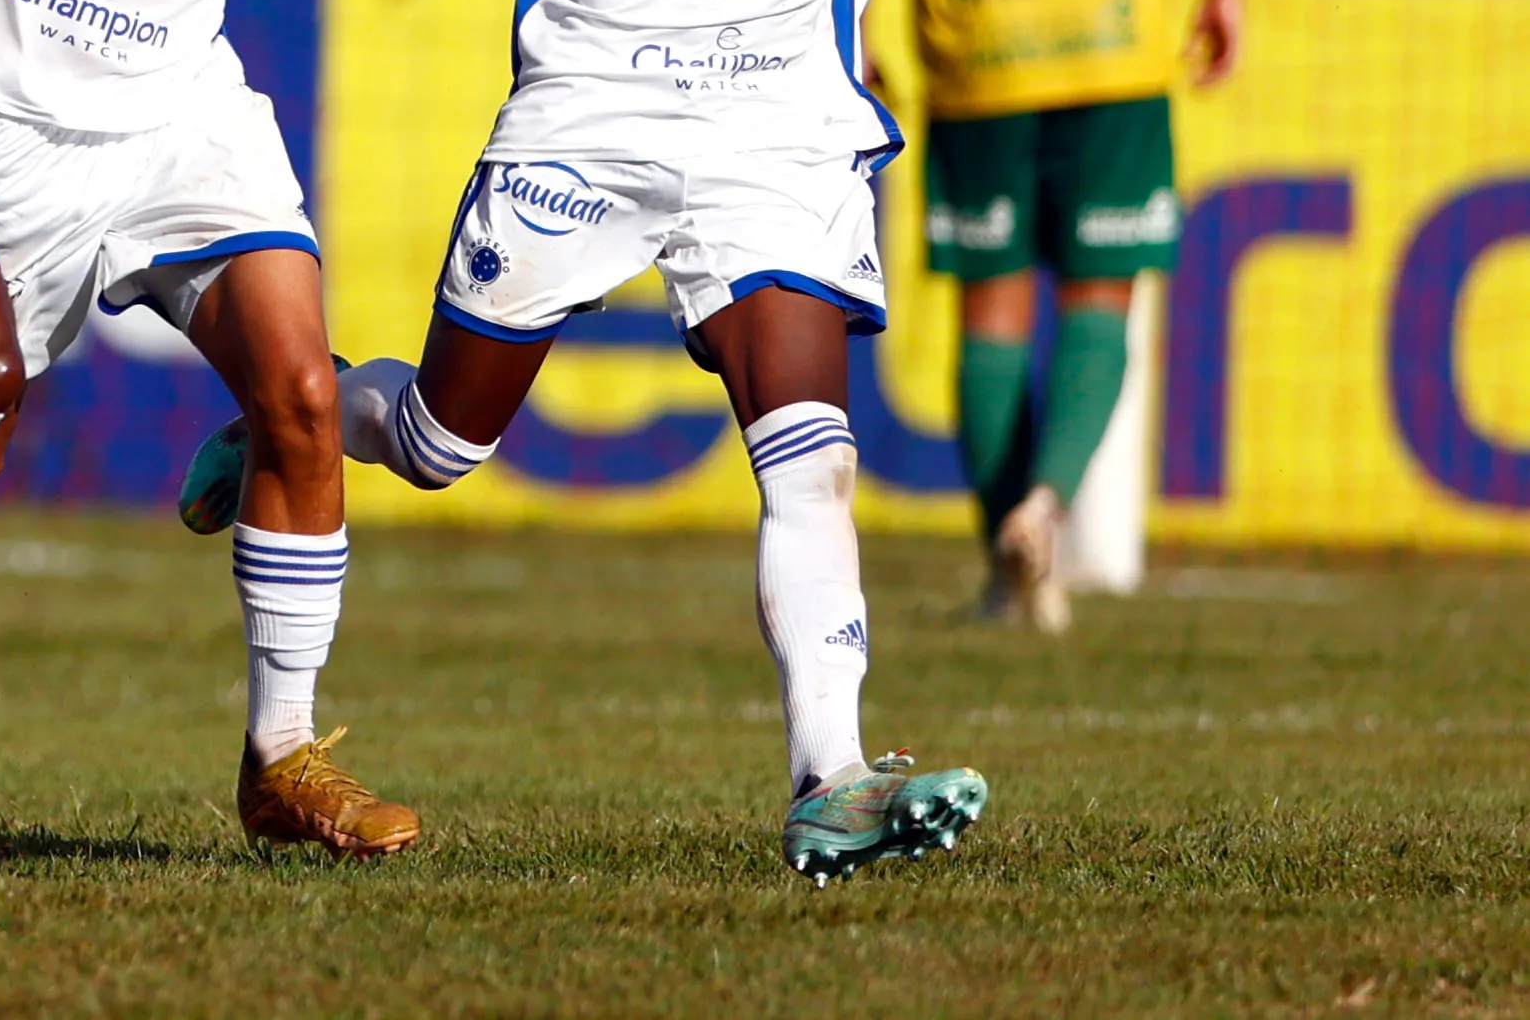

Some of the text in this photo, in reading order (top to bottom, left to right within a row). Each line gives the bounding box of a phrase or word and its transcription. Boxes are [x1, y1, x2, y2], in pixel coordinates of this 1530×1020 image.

[40, 23, 128, 63] WATCH
[674, 78, 760, 91] WATCH
[493, 163, 614, 225] Saudali
